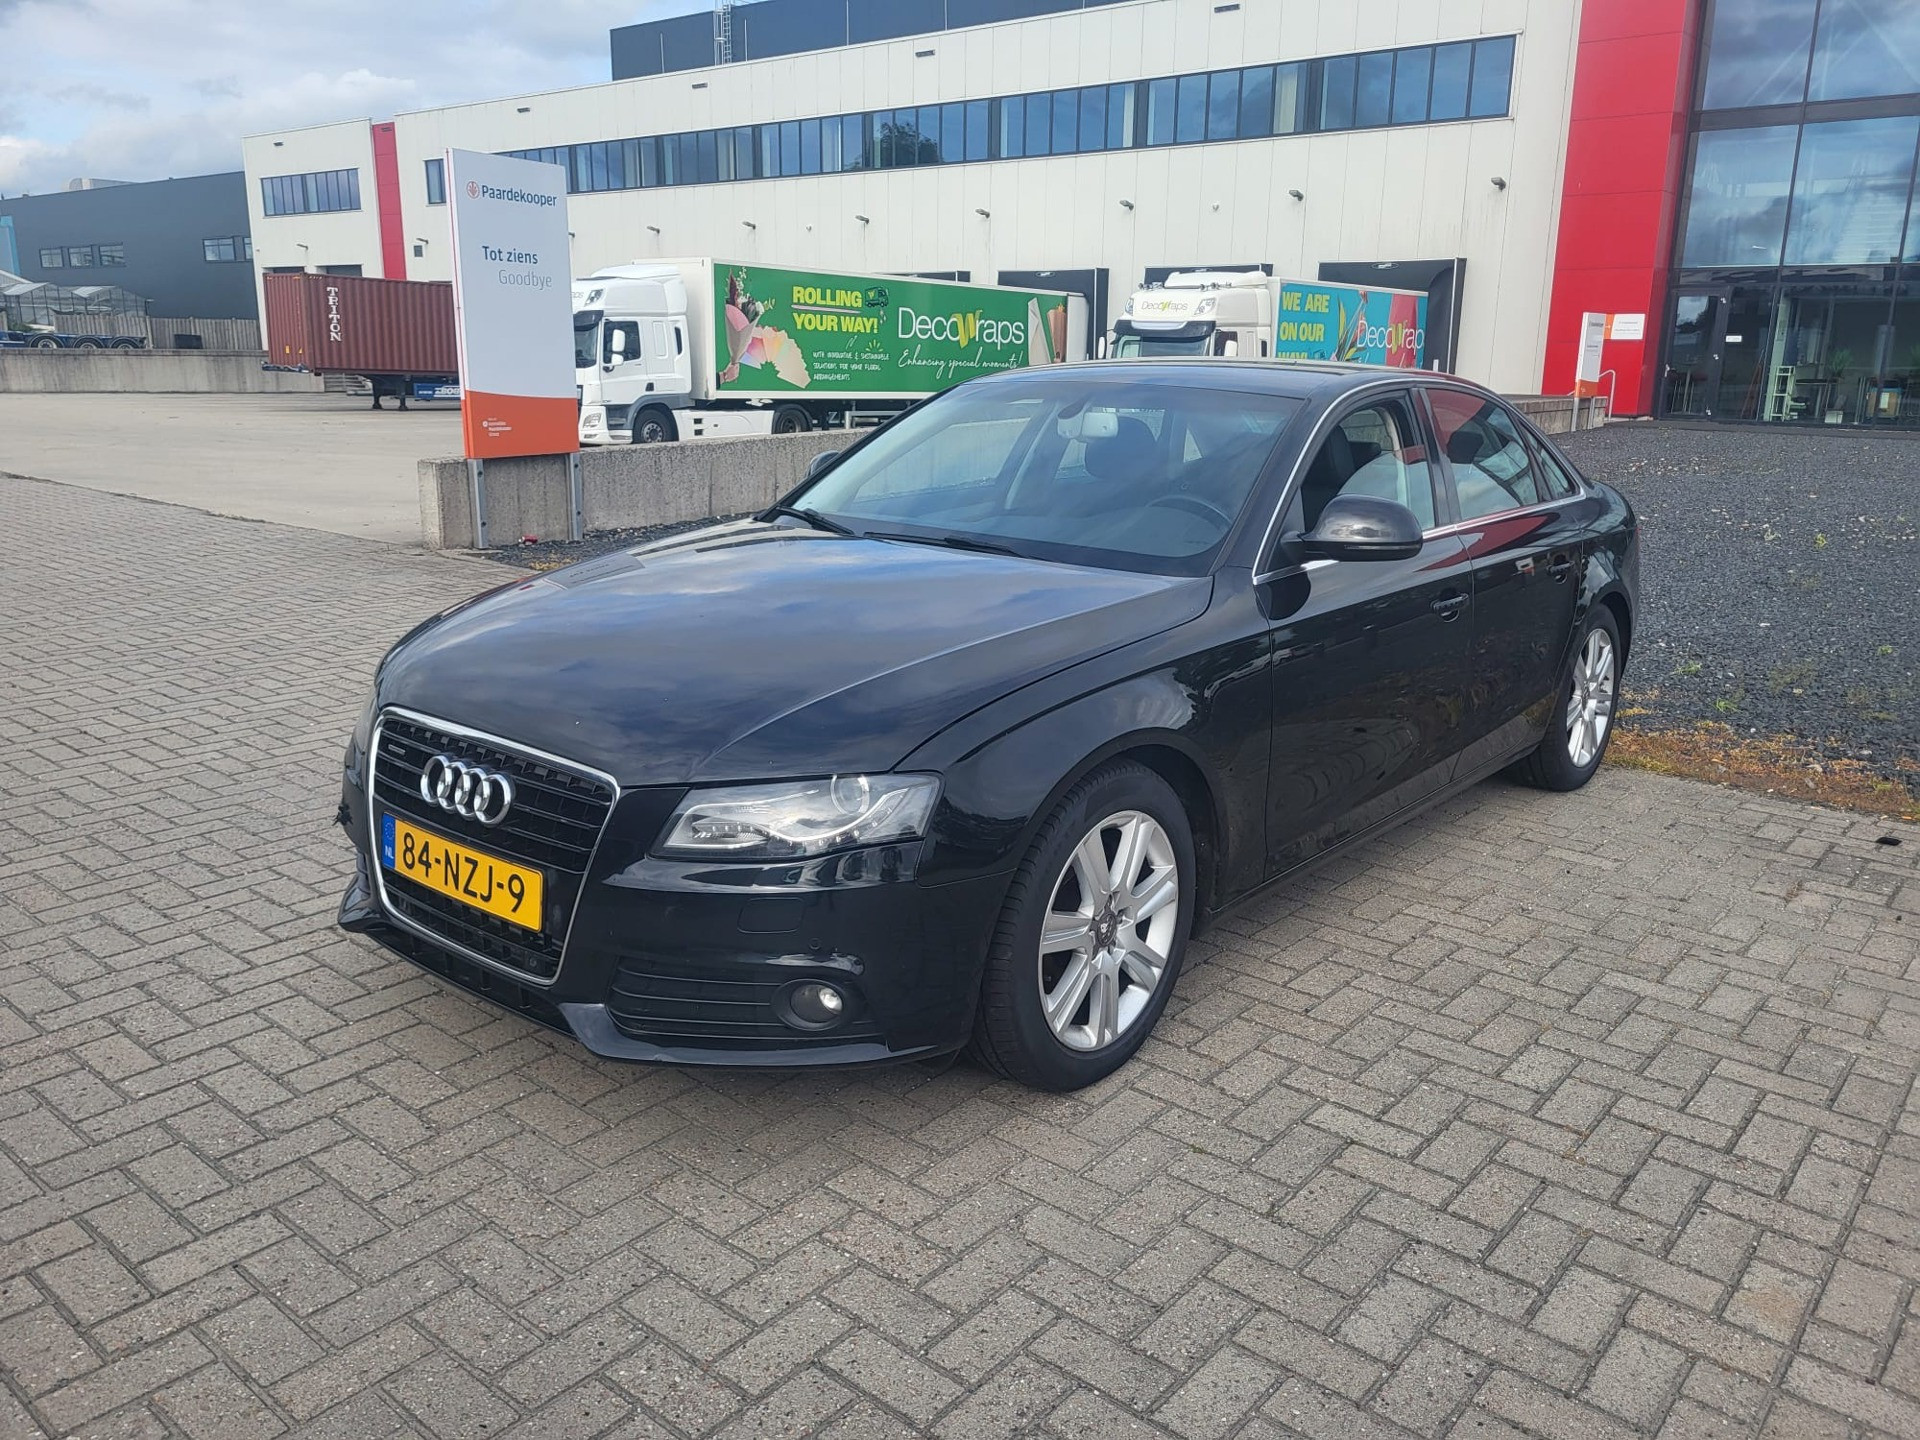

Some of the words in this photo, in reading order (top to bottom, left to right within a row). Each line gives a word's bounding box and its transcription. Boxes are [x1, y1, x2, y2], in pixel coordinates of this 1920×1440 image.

[482, 185, 557, 207] Paardekooper
[482, 245, 504, 262] Tot
[507, 248, 539, 265] ziens
[498, 269, 552, 291] Goodbye
[792, 286, 863, 308] ROLLING
[1282, 291, 1302, 312] WE
[1305, 293, 1331, 313] ARE
[326, 286, 342, 342] TRITON
[792, 312, 838, 332] YOUR
[840, 316, 879, 334] WAY!
[1280, 321, 1298, 341] ON
[1299, 323, 1325, 342] OUR
[898, 344, 946, 379] Enhancing
[948, 346, 983, 379] special
[384, 845, 394, 860] NL
[402, 832, 526, 913] 84-NZJ-9
